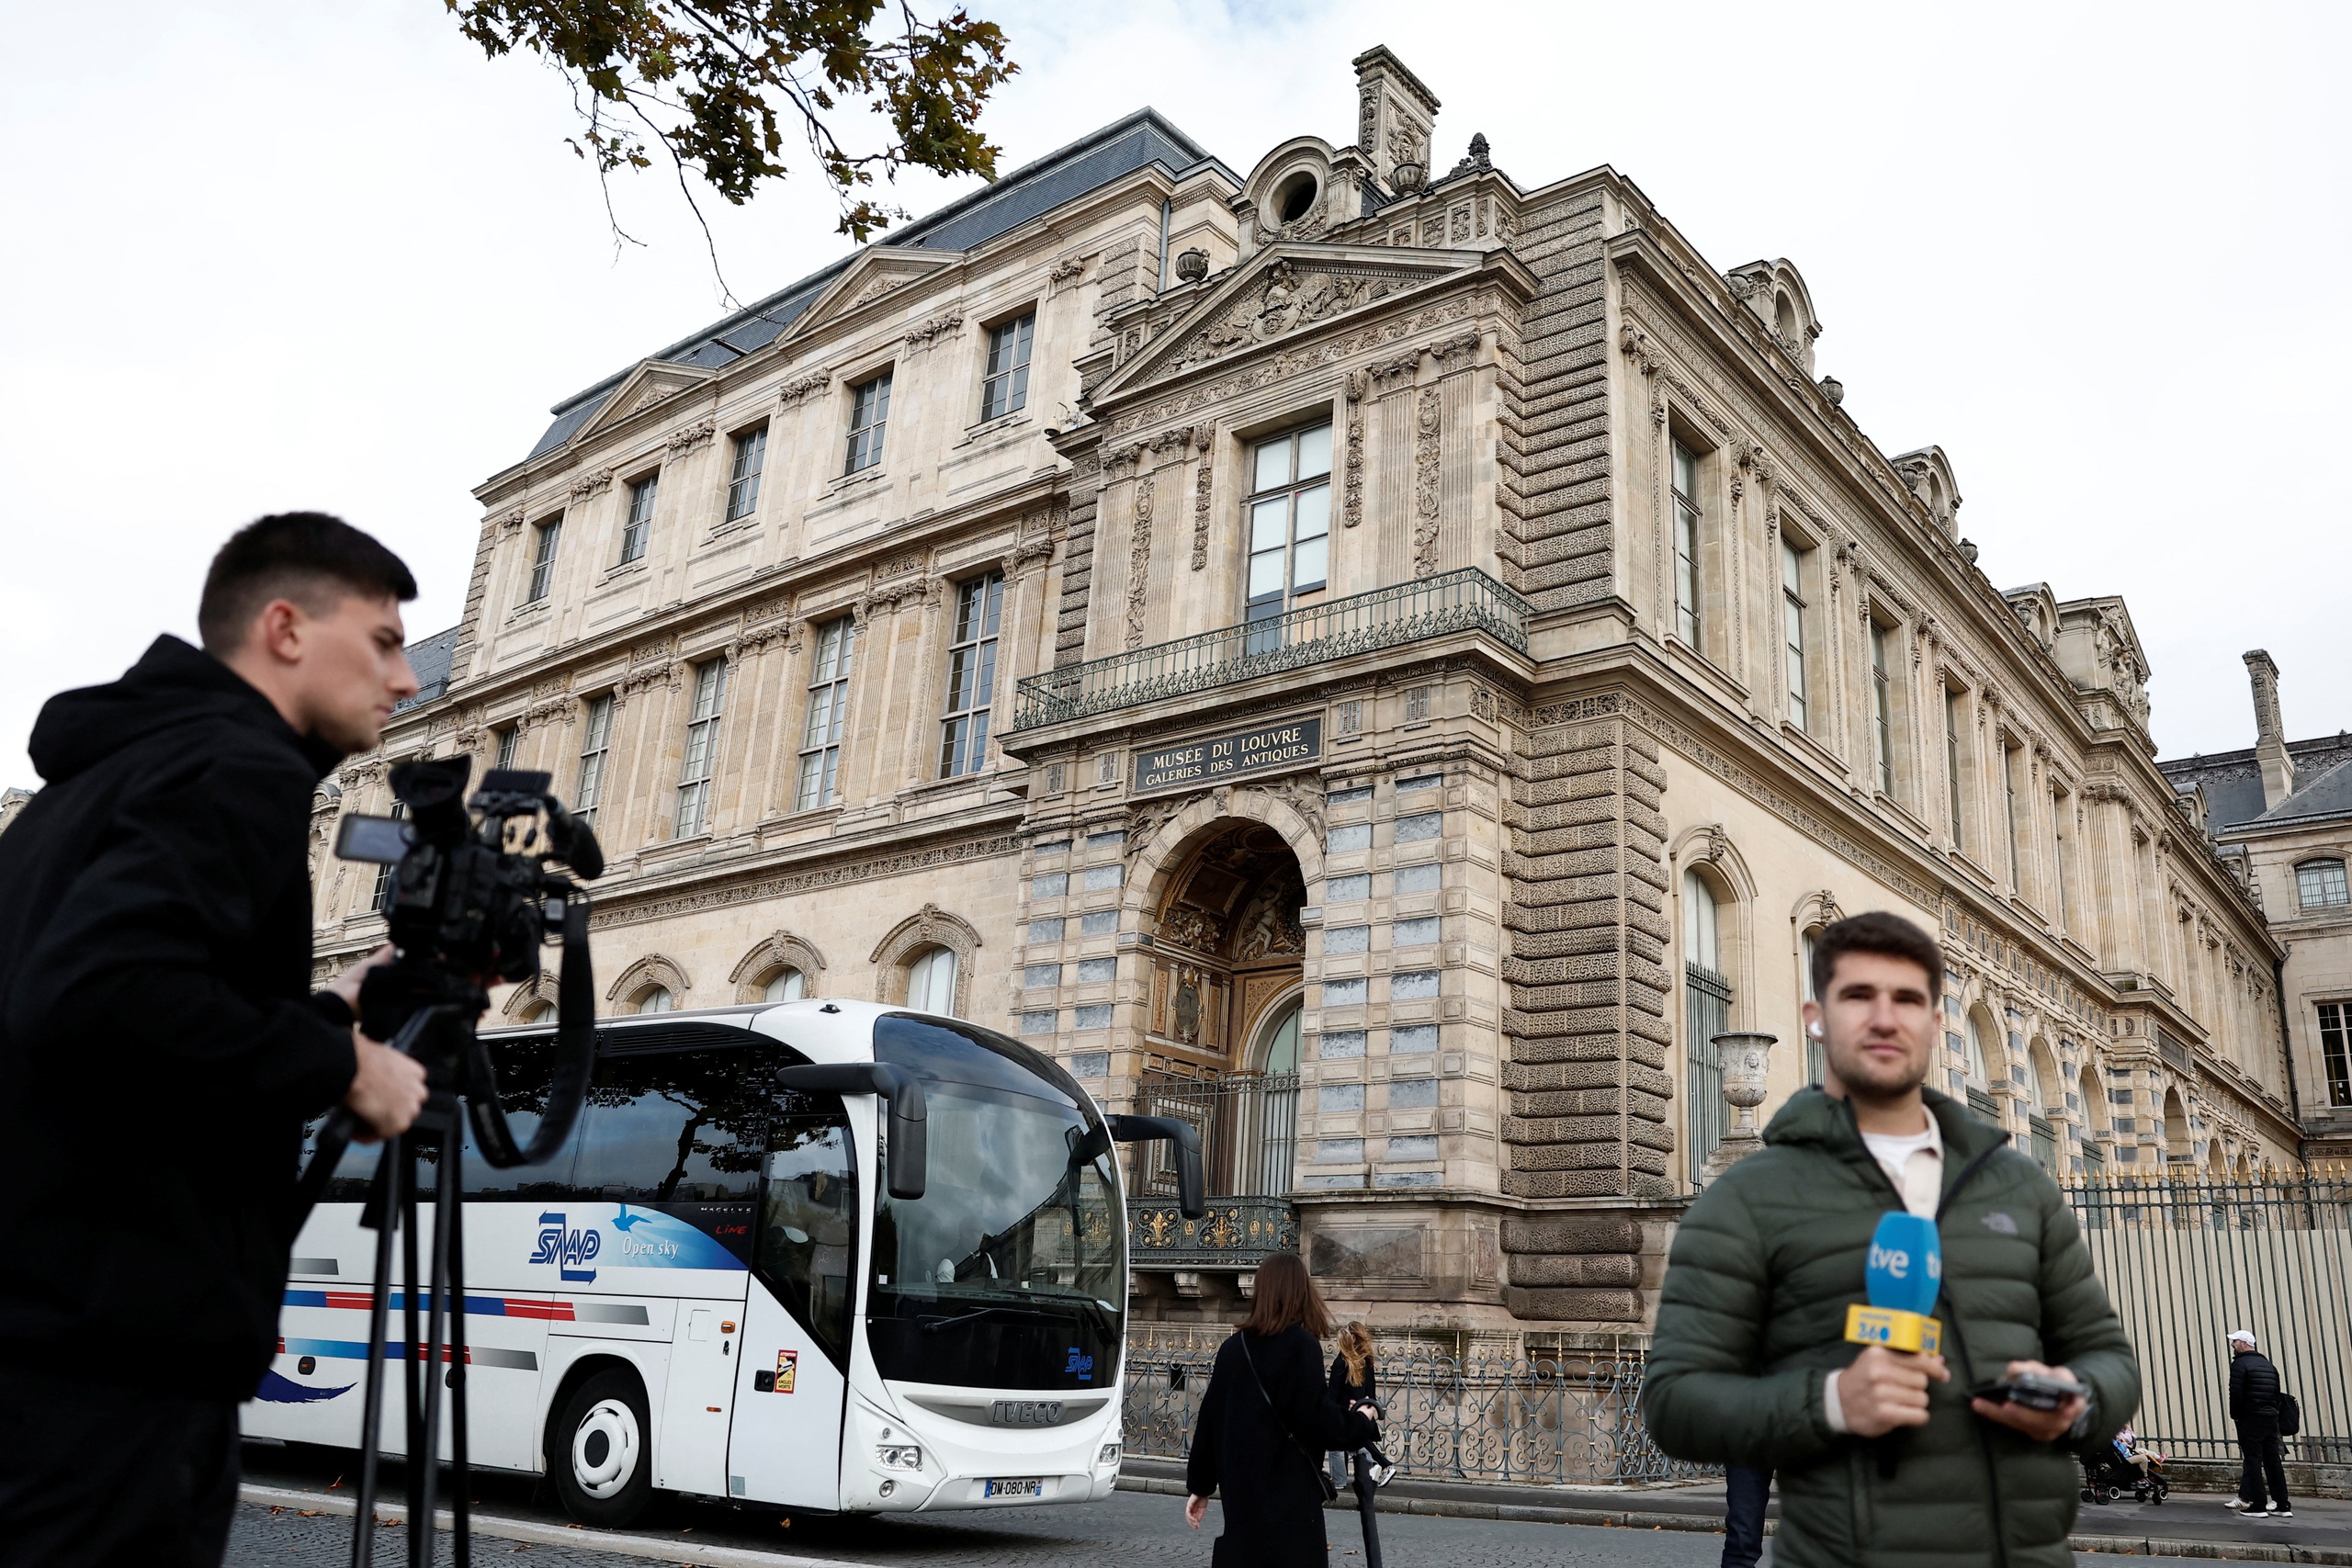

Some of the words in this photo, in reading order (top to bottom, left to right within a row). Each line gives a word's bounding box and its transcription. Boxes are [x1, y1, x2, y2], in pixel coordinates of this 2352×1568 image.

[1152, 747, 1204, 770] MUSÉE
[1212, 741, 1233, 758] DU
[1240, 727, 1301, 752] LOUVRE
[1146, 765, 1202, 785] GALERIES
[1210, 760, 1234, 773] DES
[1242, 744, 1309, 767] ANTIQUES
[623, 1236, 654, 1258] Open
[658, 1240, 679, 1259] sky
[1869, 1241, 1909, 1279] tve
[993, 1401, 1061, 1423] IVECO
[990, 1481, 1036, 1495] DM-080-NR
